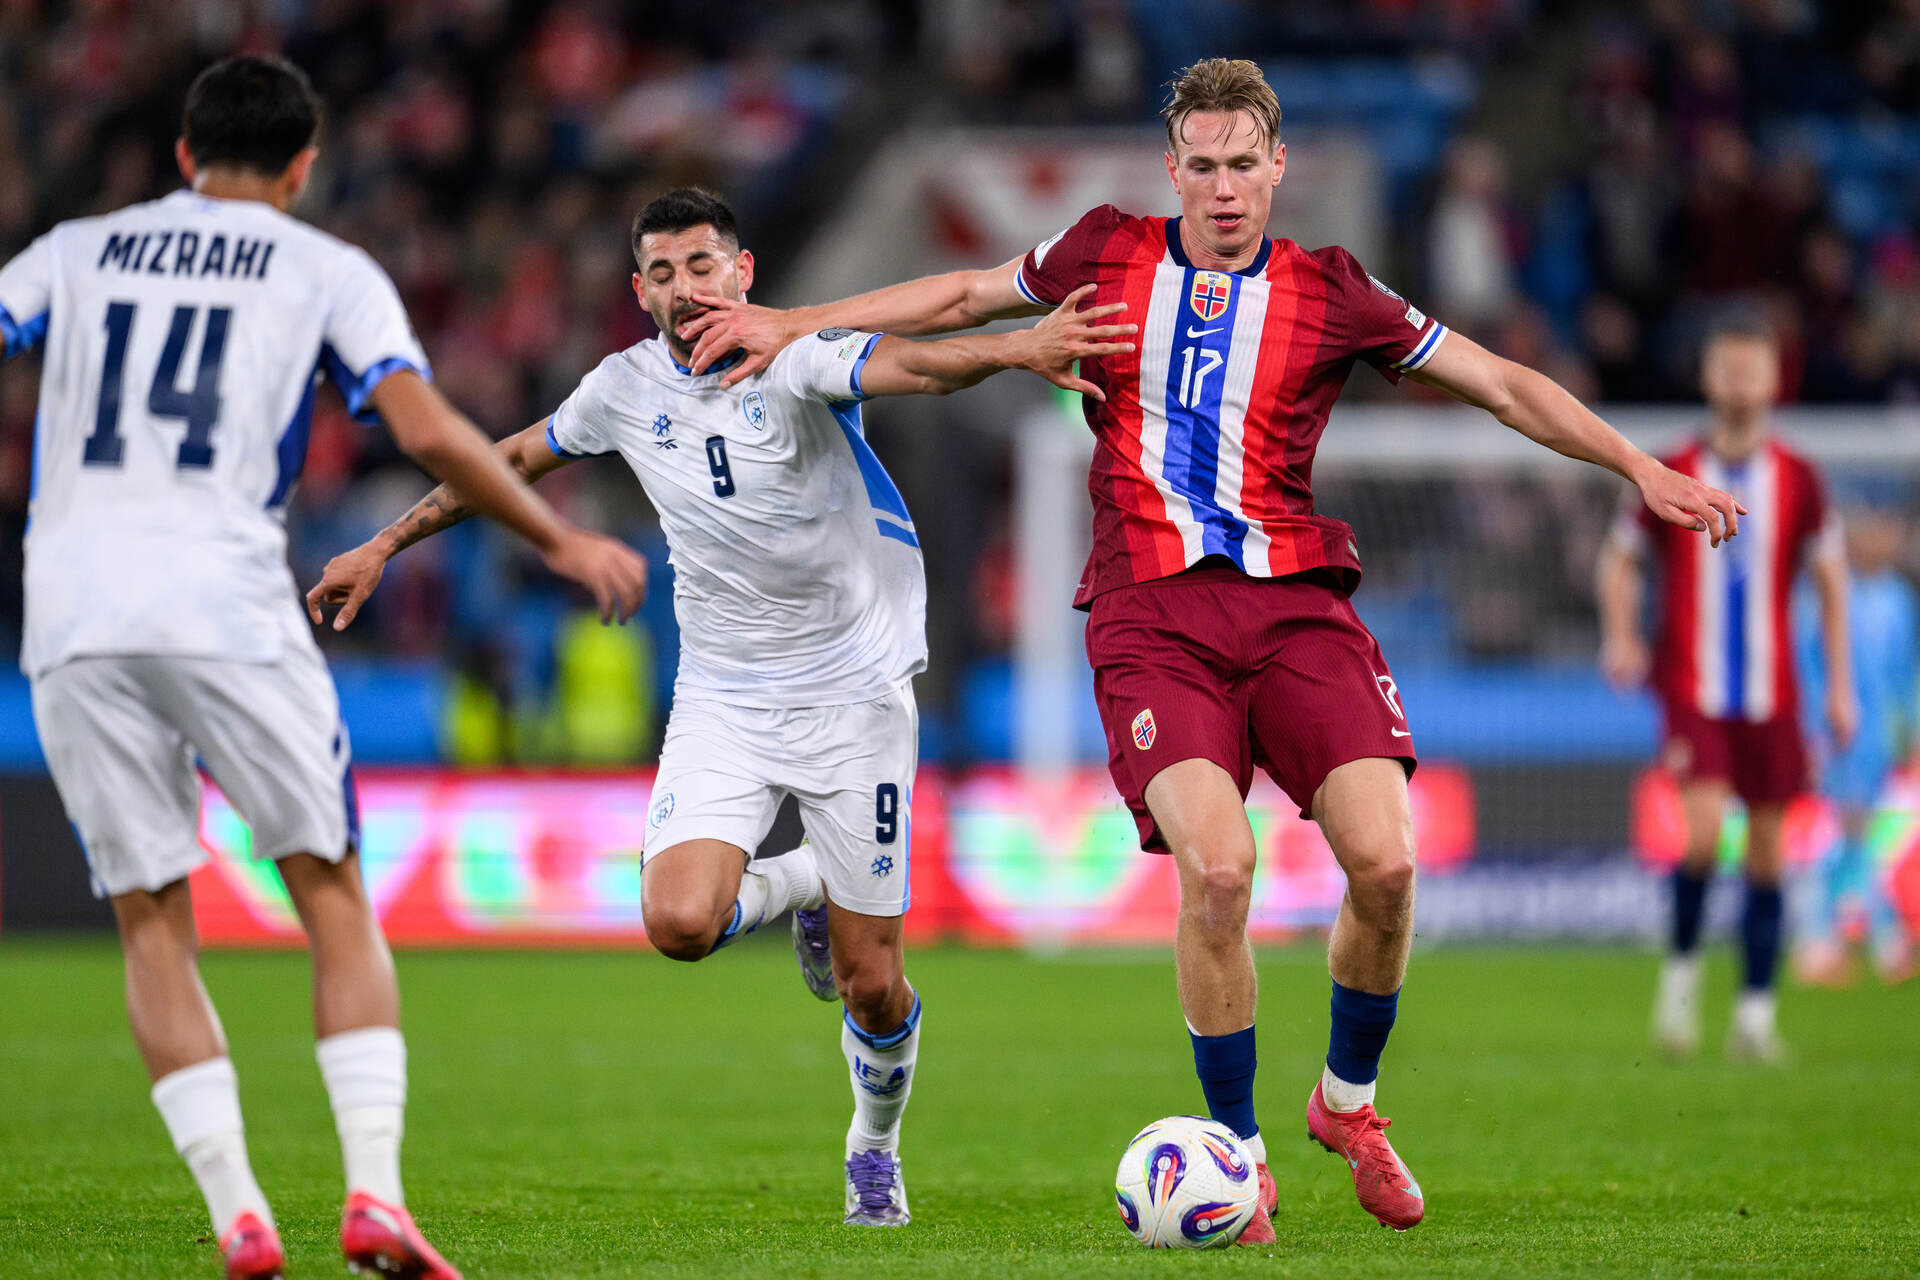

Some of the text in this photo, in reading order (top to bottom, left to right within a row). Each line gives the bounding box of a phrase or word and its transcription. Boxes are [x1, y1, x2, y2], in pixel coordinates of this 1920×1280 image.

[99, 231, 276, 281] MIZRAHI
[81, 301, 233, 469] 14
[1178, 346, 1224, 409] 17
[705, 434, 736, 499] 9
[876, 782, 898, 844] 9
[855, 1055, 905, 1085] IFA
